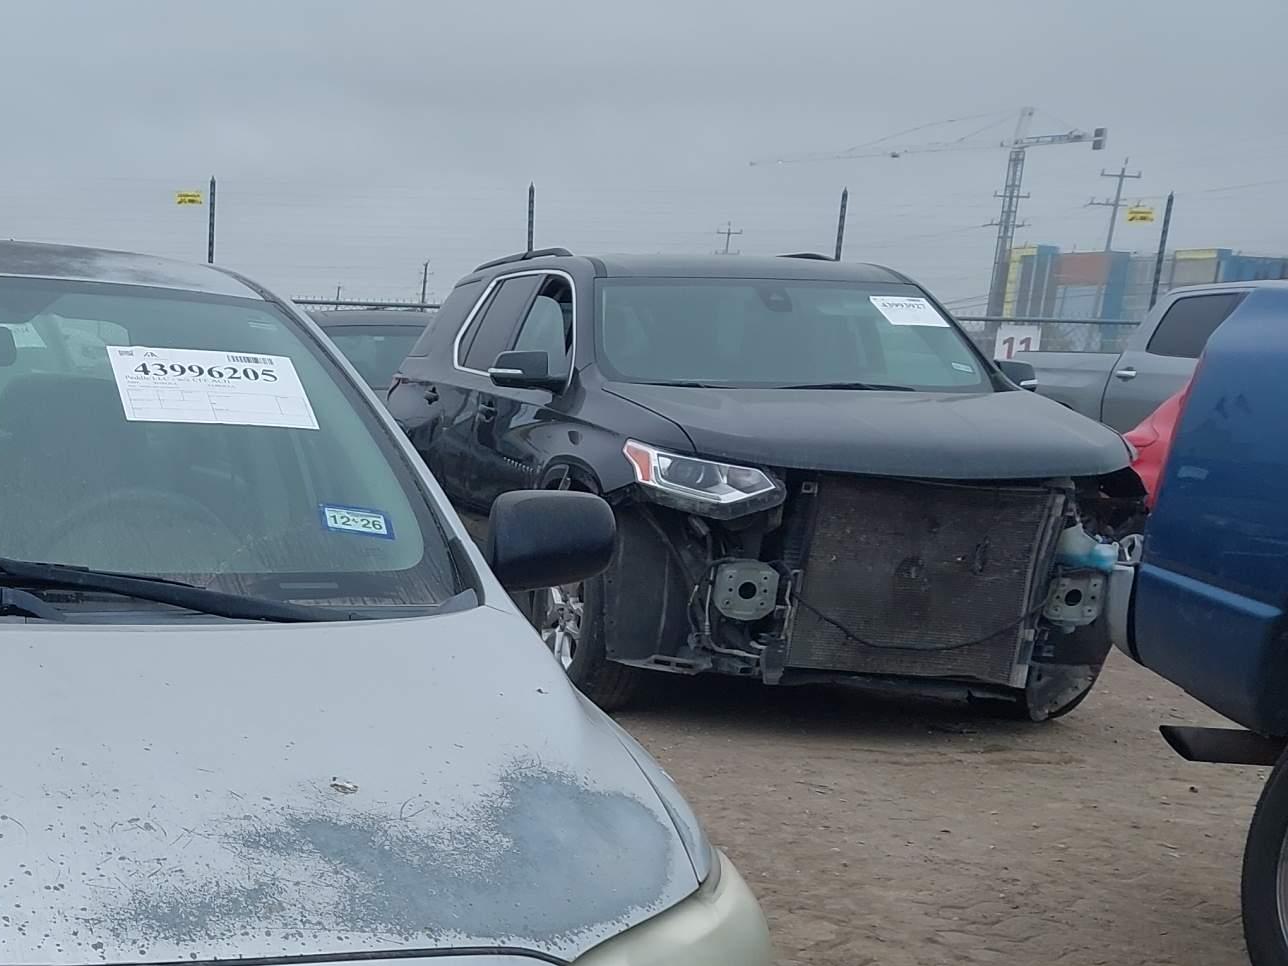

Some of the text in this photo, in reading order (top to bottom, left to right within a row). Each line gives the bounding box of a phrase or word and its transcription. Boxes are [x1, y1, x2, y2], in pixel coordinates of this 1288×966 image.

[1002, 336, 1032, 360] 11
[134, 361, 279, 383] 43996205
[329, 514, 383, 531] 12 26
